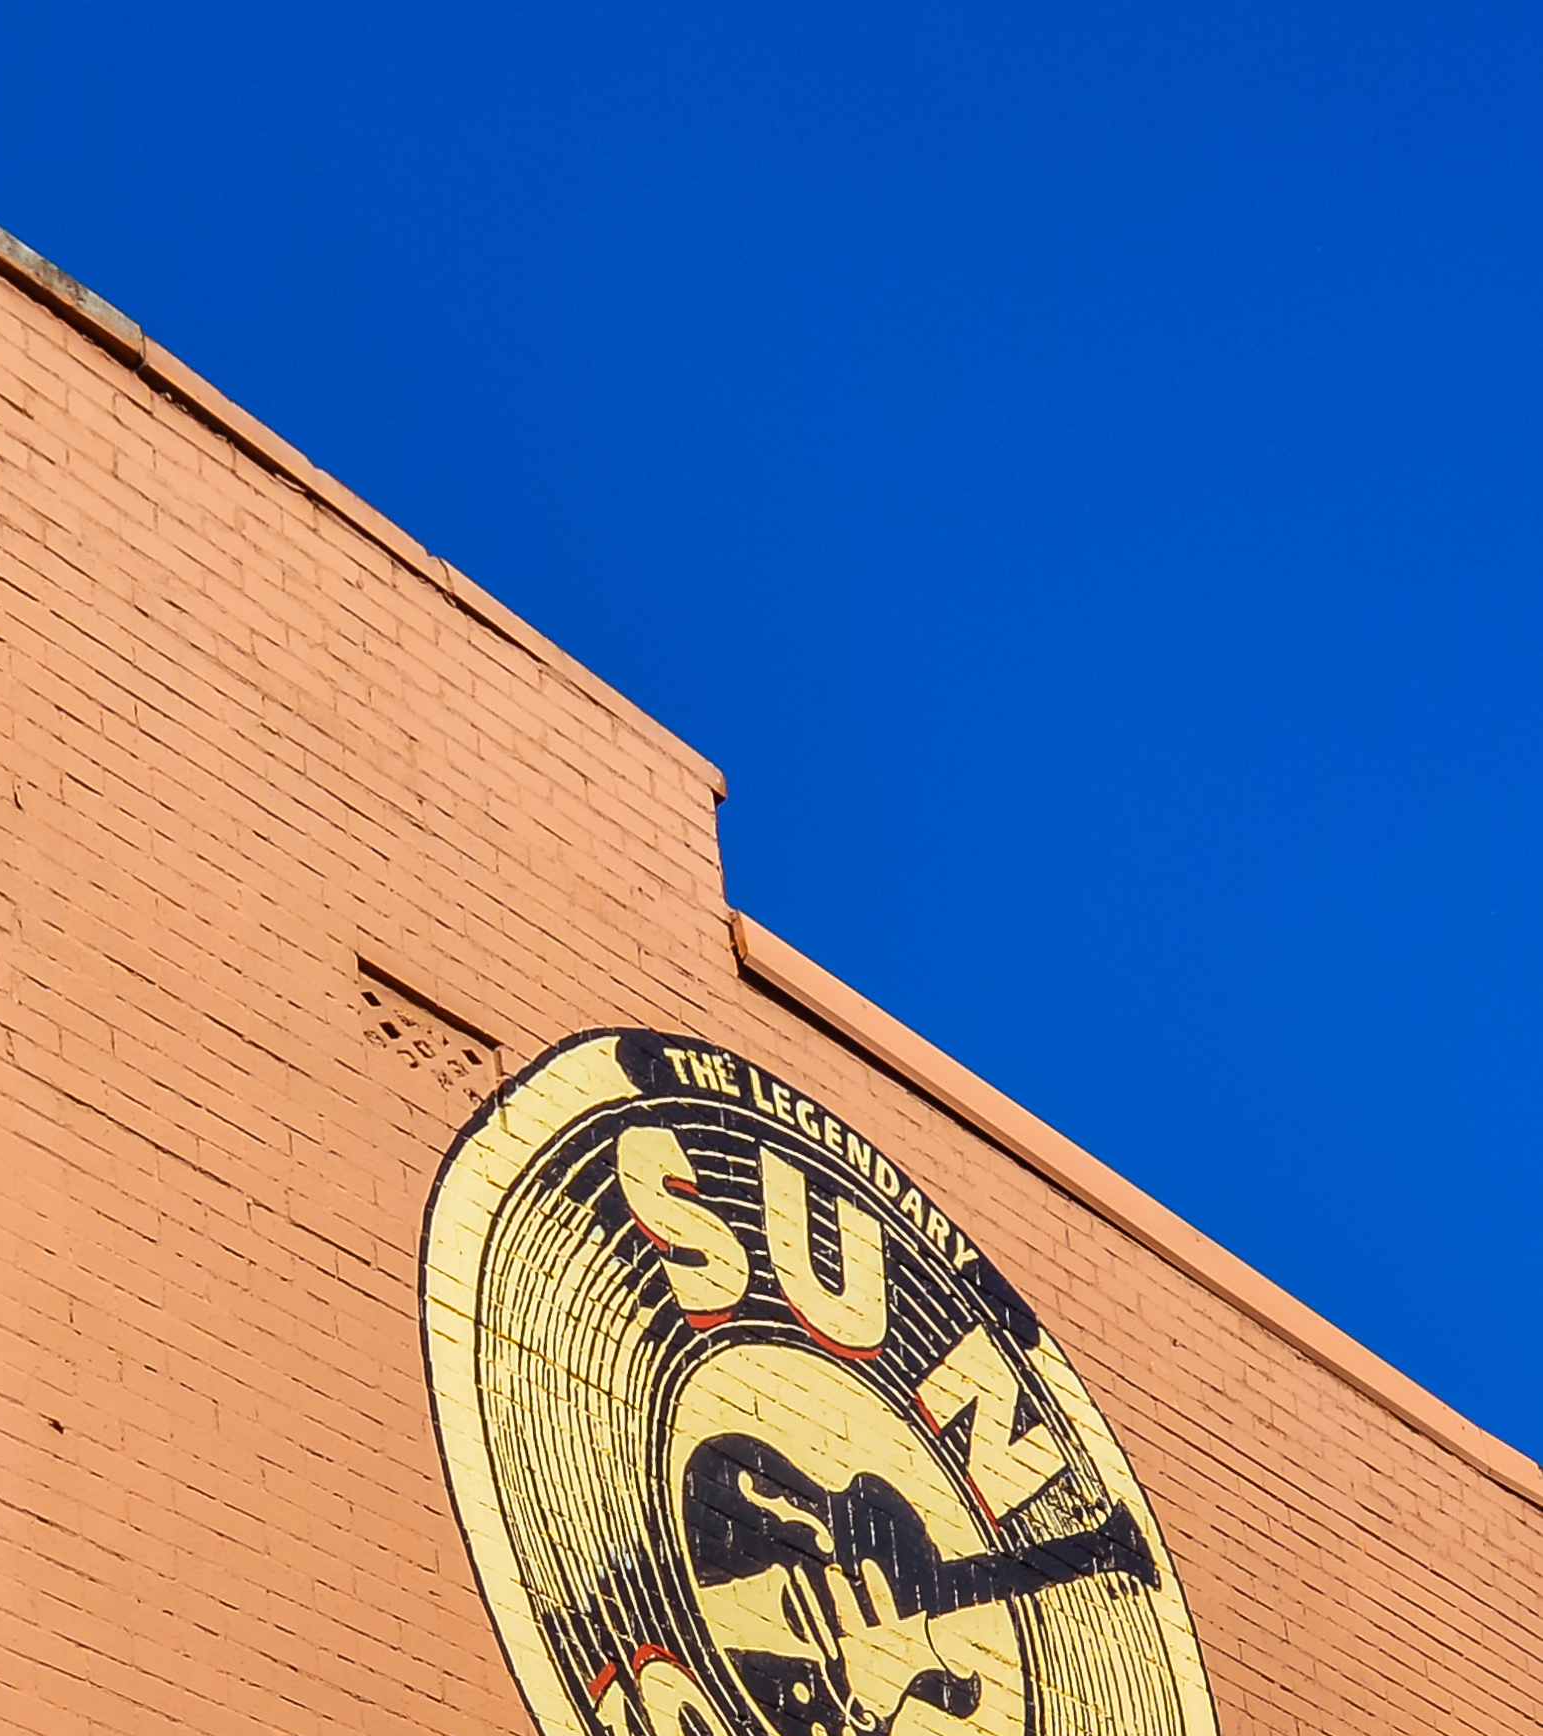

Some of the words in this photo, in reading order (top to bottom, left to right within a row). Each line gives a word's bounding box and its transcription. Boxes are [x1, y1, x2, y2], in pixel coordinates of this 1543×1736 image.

[662, 1046, 741, 1098] THE
[747, 1065, 979, 1271] LEGENDARY
[616, 1125, 1068, 1531] SUN
